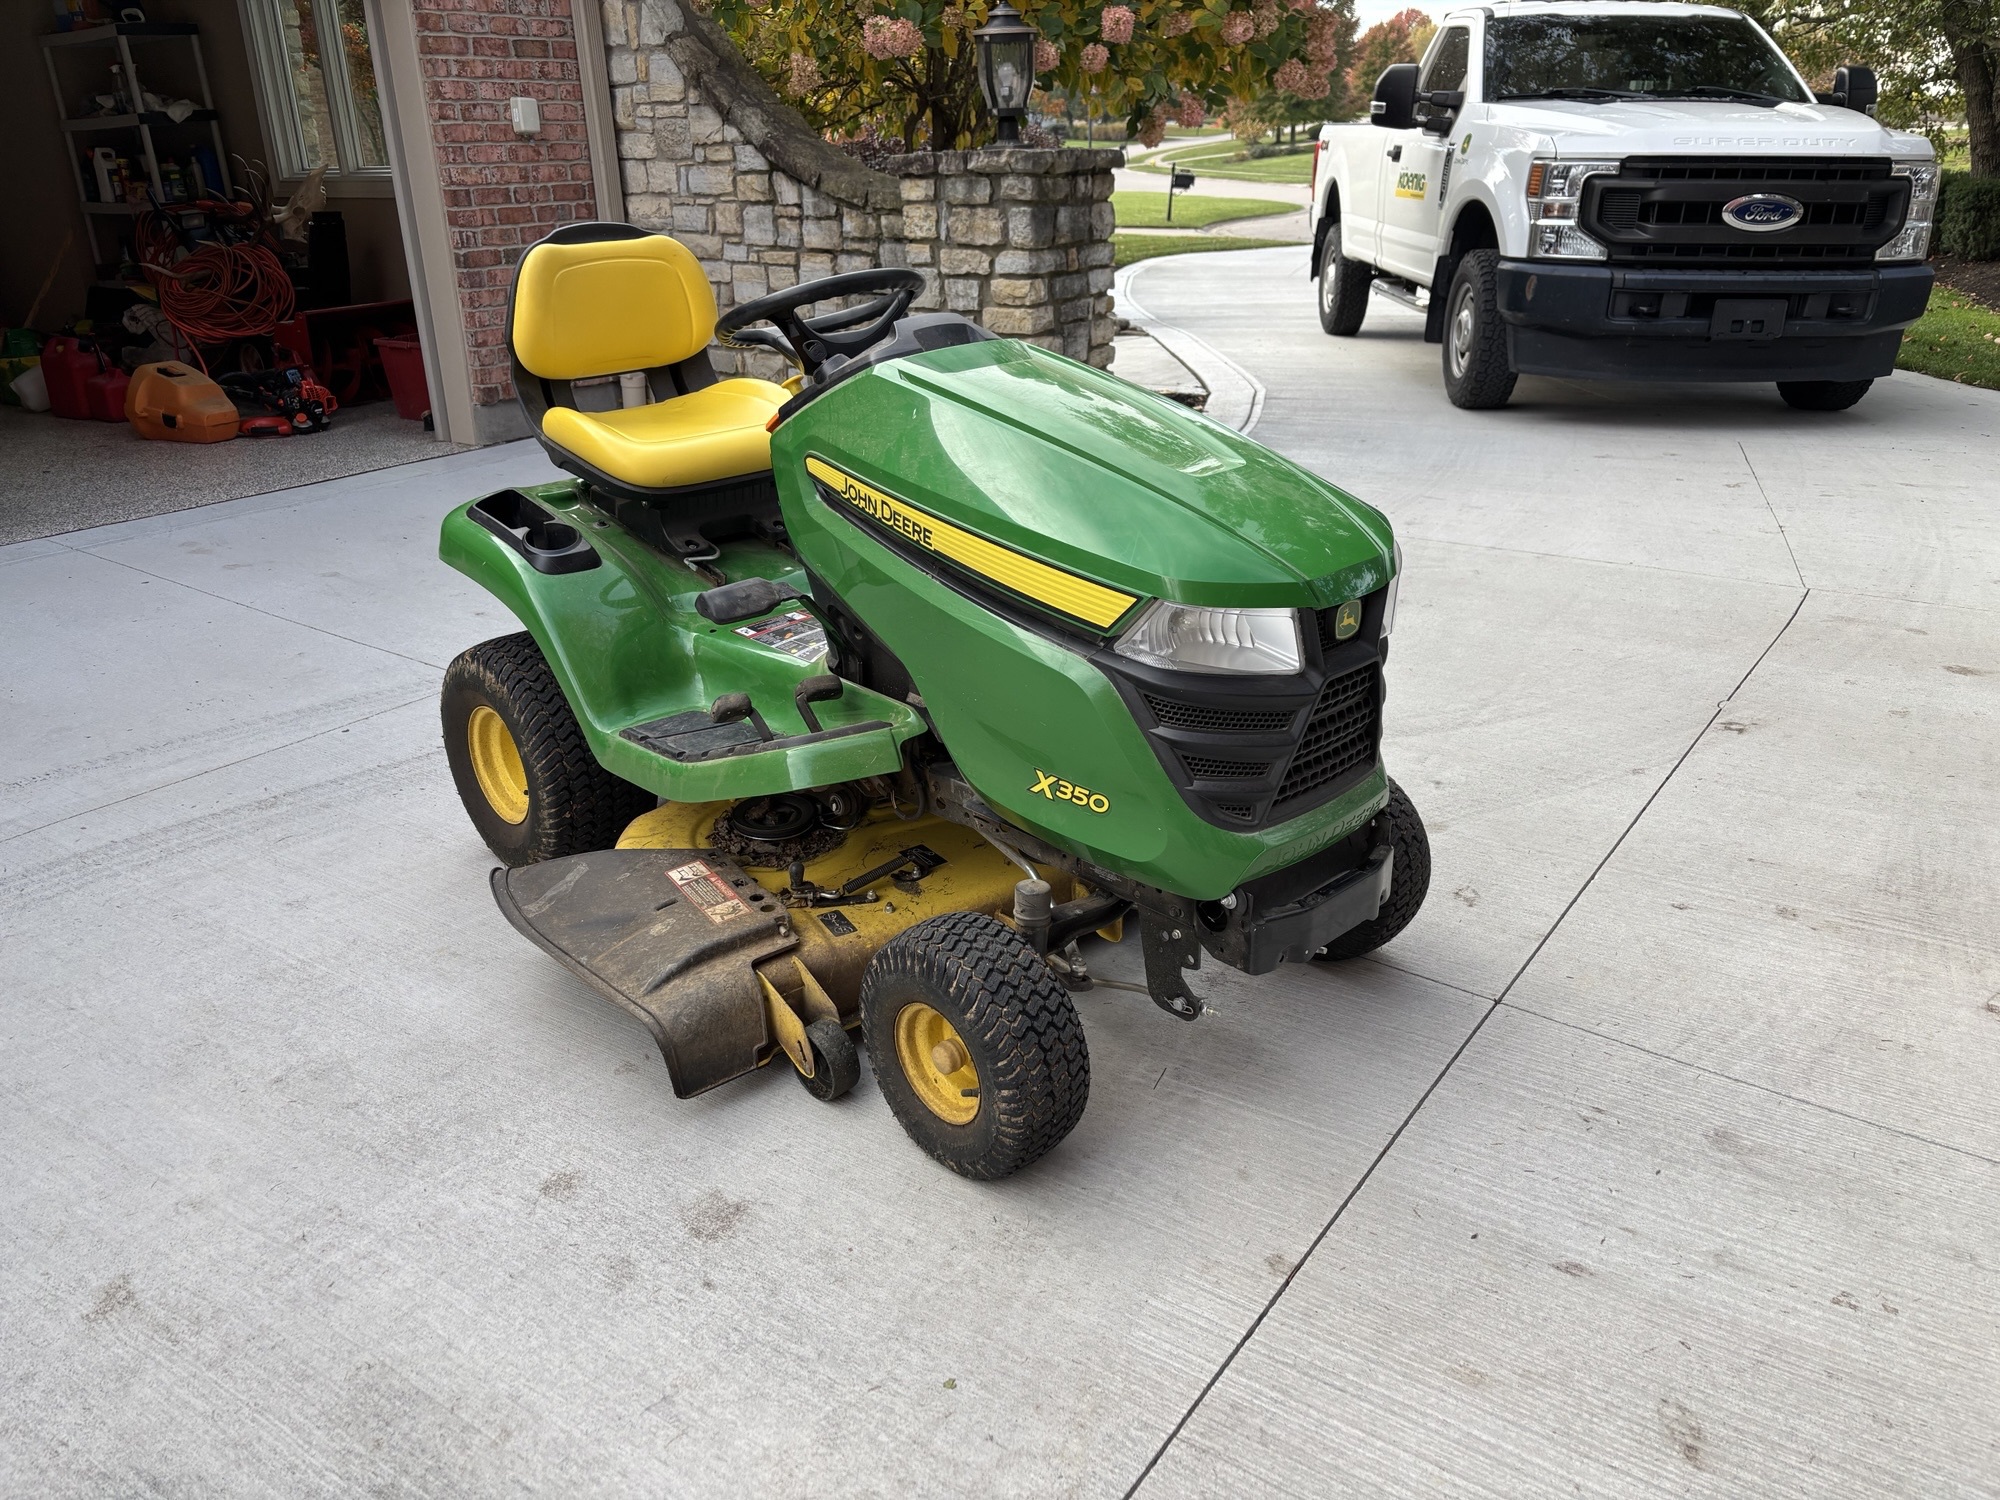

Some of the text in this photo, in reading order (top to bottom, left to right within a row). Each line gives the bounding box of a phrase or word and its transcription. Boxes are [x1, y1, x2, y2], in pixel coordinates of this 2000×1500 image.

[1673, 136, 1857, 147] SUPER DUTY
[1744, 203, 1783, 221] Ford
[840, 477, 934, 548] JOHN DEERE
[1027, 767, 1110, 814] X350
